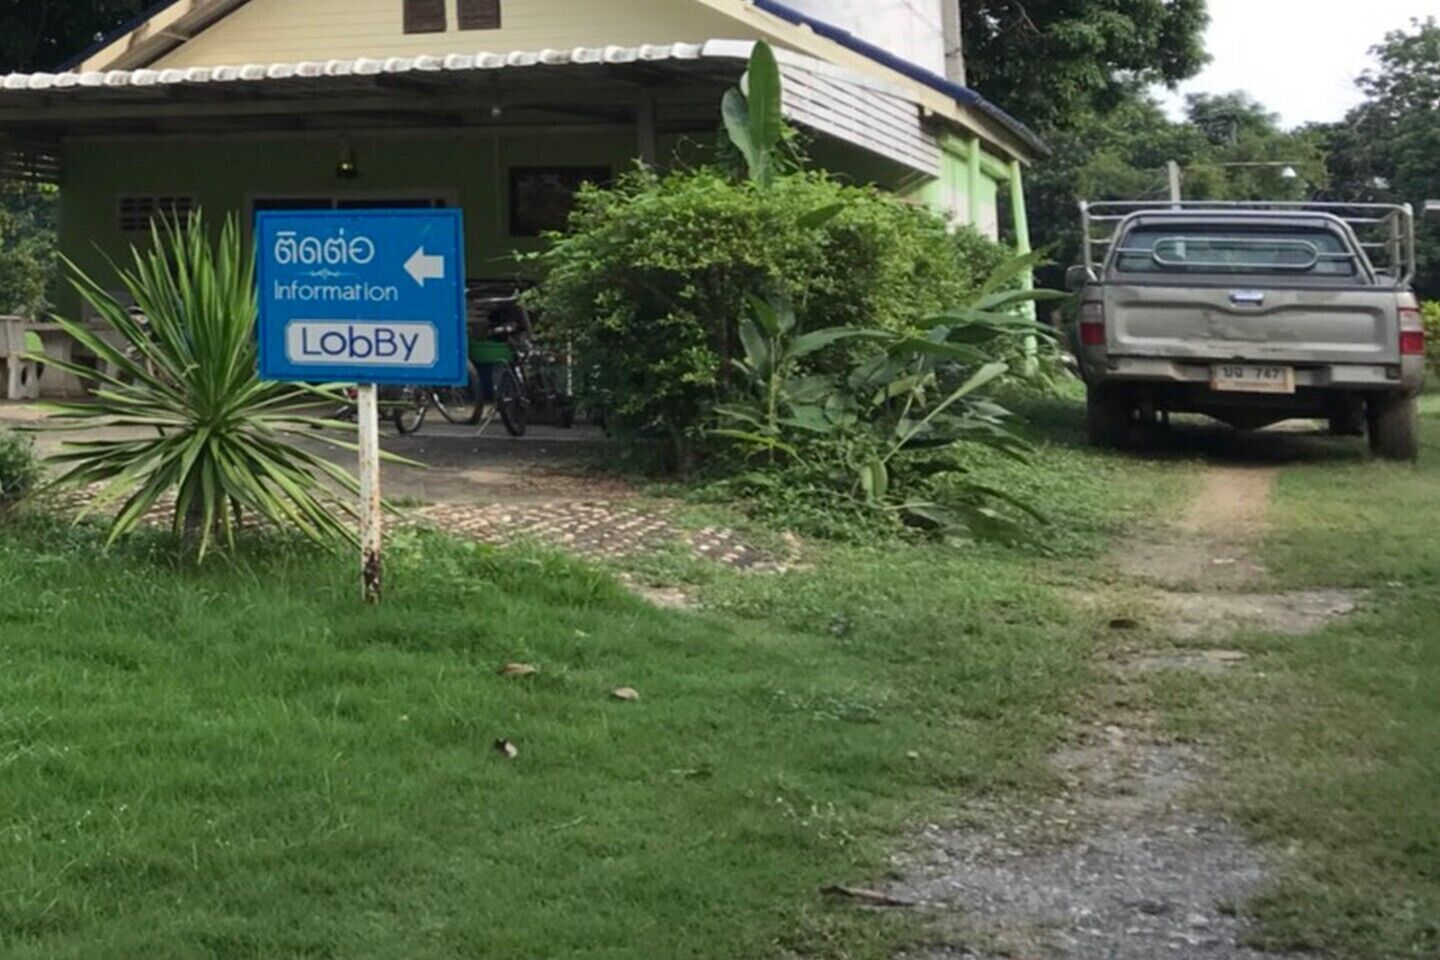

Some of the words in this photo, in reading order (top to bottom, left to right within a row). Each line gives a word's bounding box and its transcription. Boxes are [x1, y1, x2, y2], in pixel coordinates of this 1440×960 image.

[274, 227, 375, 264] ติดต่อ
[274, 280, 398, 301] Information
[301, 326, 419, 361] LobBy
